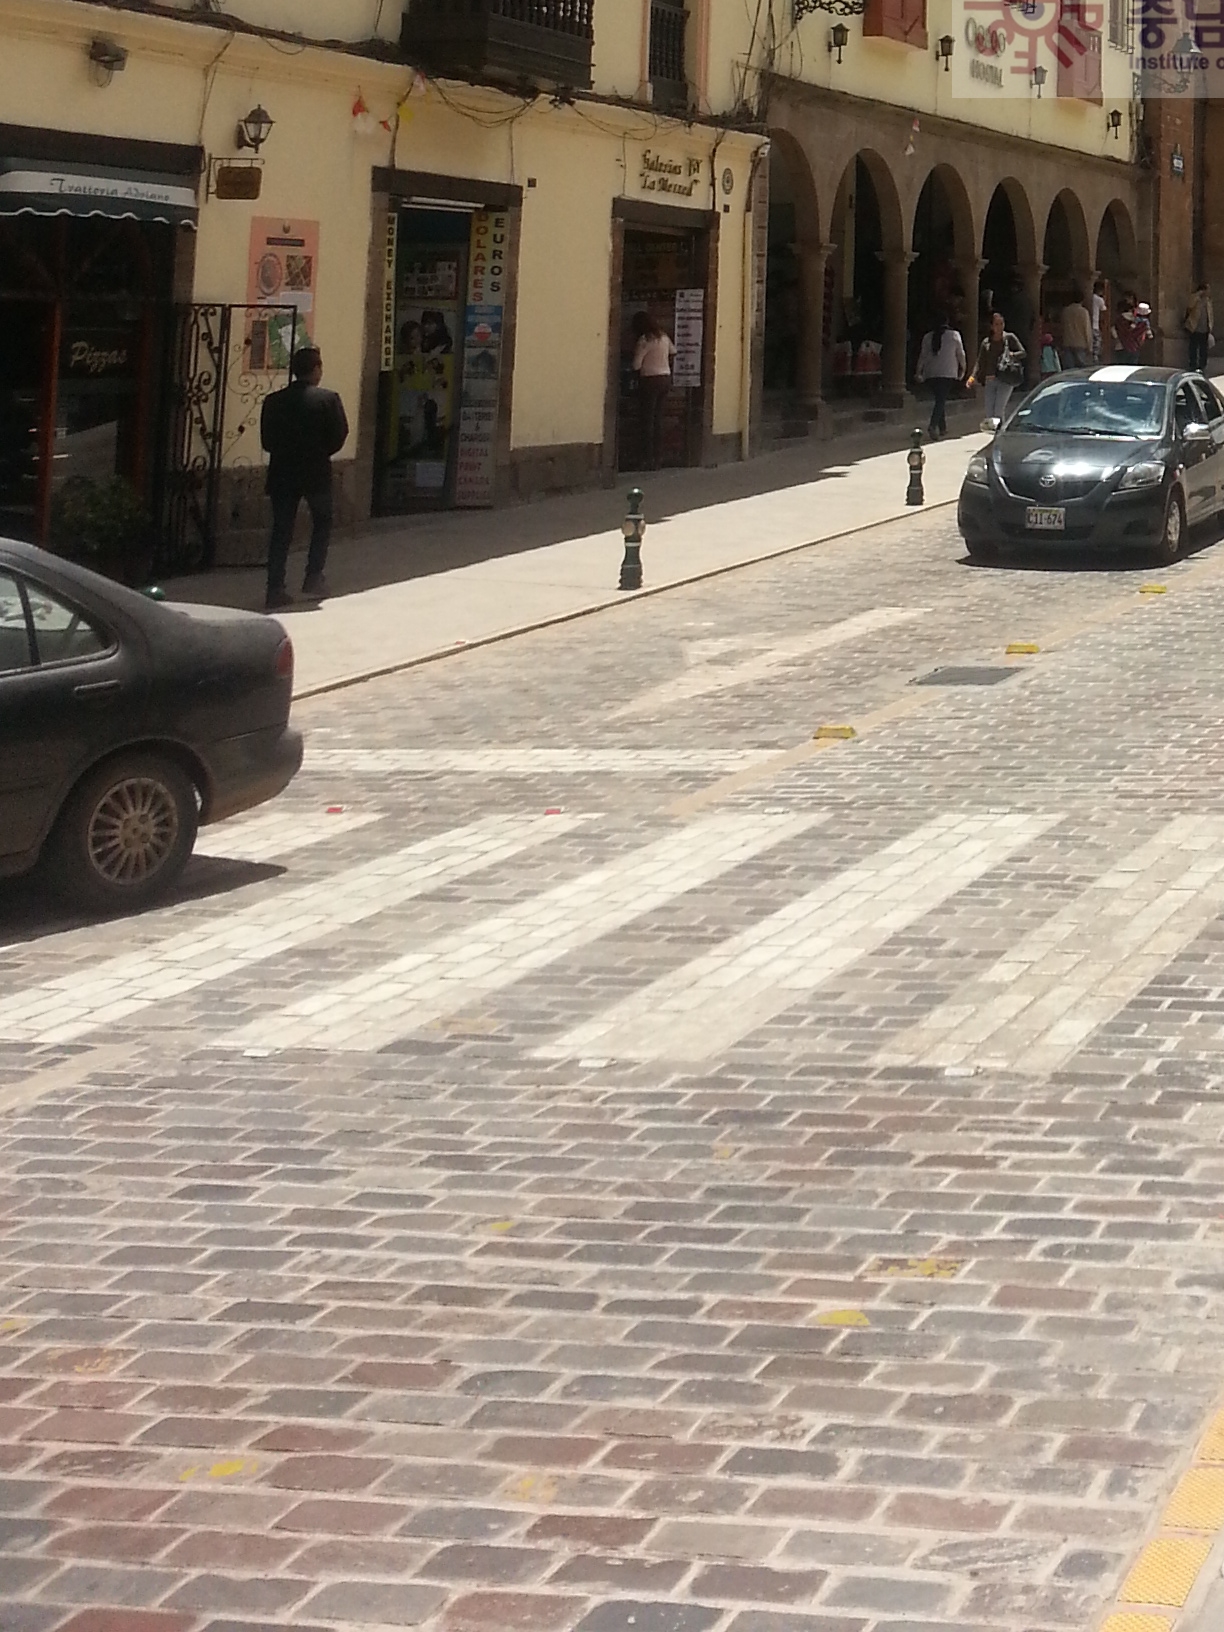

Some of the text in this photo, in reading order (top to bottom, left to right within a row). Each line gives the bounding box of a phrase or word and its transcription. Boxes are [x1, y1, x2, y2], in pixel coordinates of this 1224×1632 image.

[50, 178, 119, 196] Trattoria
[386, 215, 396, 269] MONEY
[472, 211, 489, 302] DOLARES
[490, 218, 505, 292] EUROS
[69, 340, 128, 373] Pizzas
